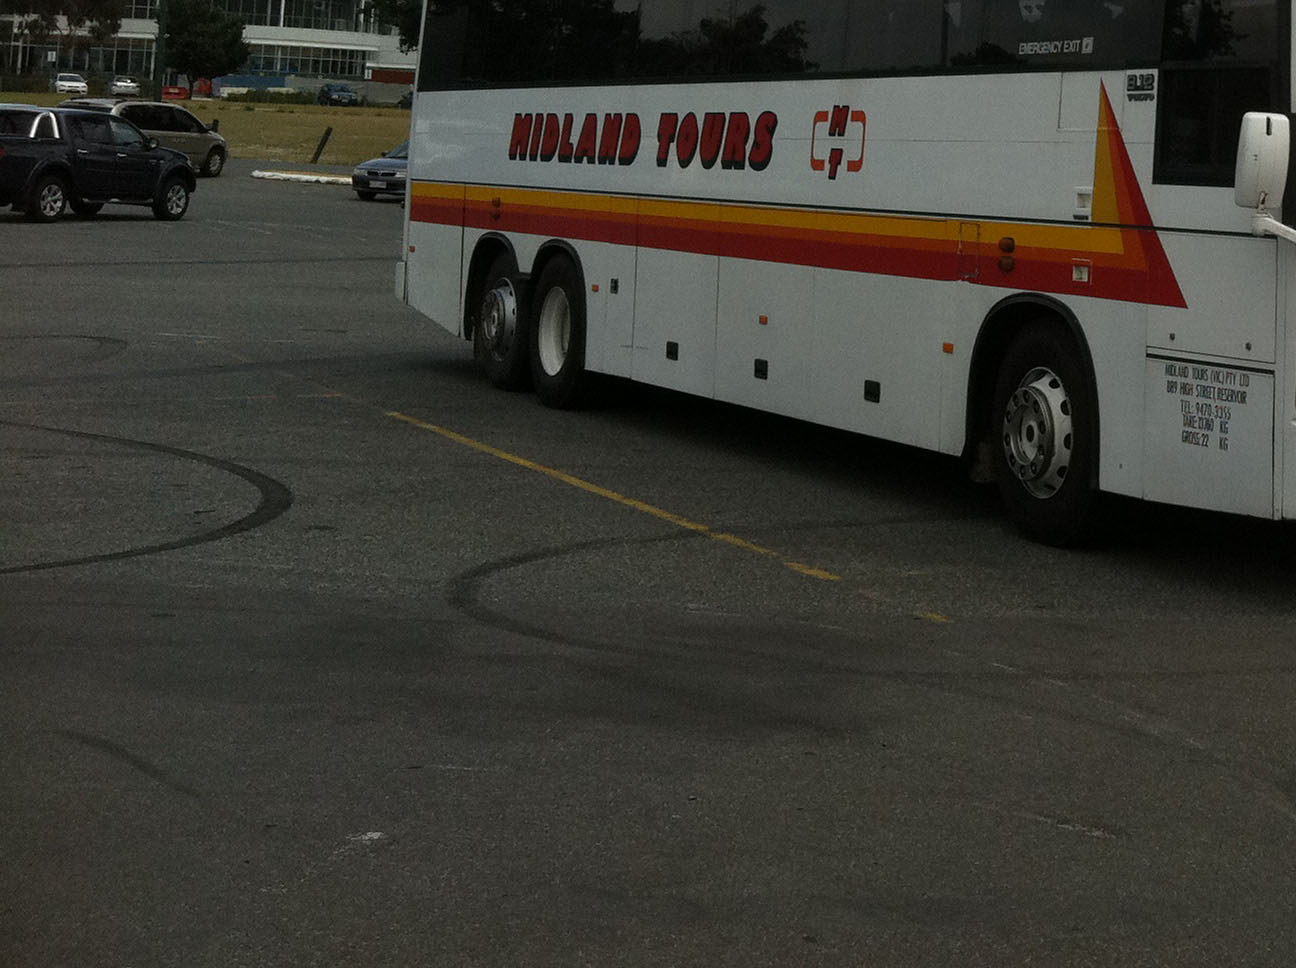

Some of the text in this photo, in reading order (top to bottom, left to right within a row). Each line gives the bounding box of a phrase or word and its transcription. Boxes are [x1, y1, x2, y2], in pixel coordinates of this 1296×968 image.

[1018, 39, 1081, 54] EMERGENCY EXIT
[508, 111, 778, 171] MIDLAND TOURS
